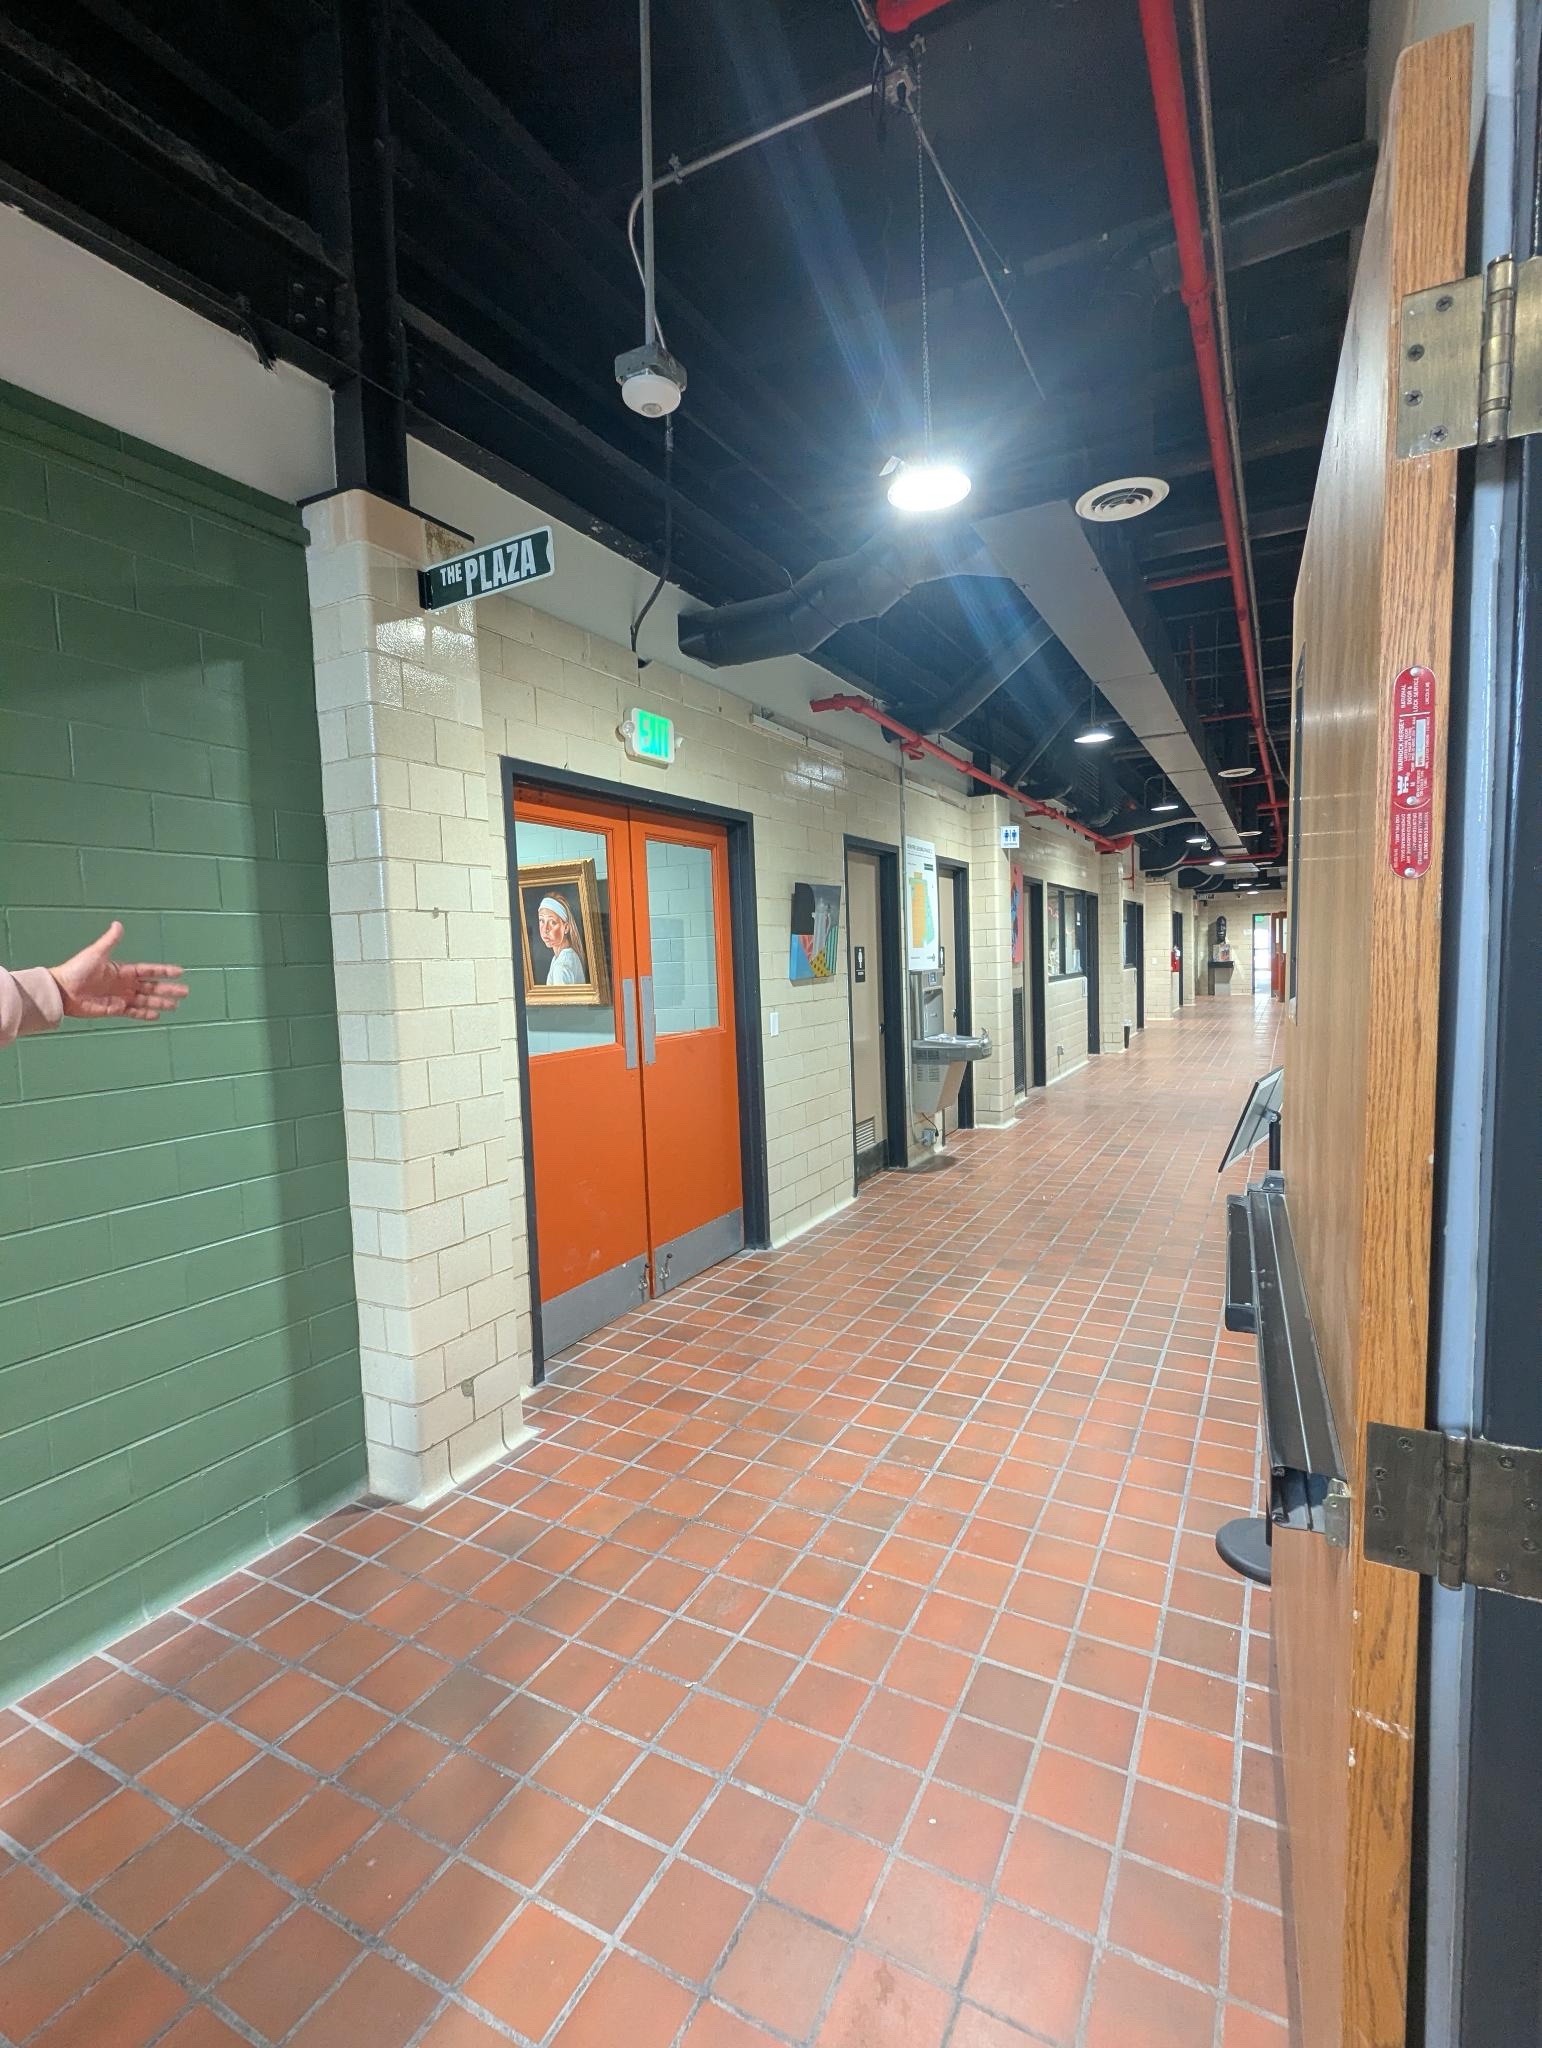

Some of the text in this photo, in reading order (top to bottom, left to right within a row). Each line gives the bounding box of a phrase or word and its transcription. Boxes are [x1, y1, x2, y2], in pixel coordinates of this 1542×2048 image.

[440, 538, 536, 596] THE PLAZA
[639, 711, 669, 757] EXIT
